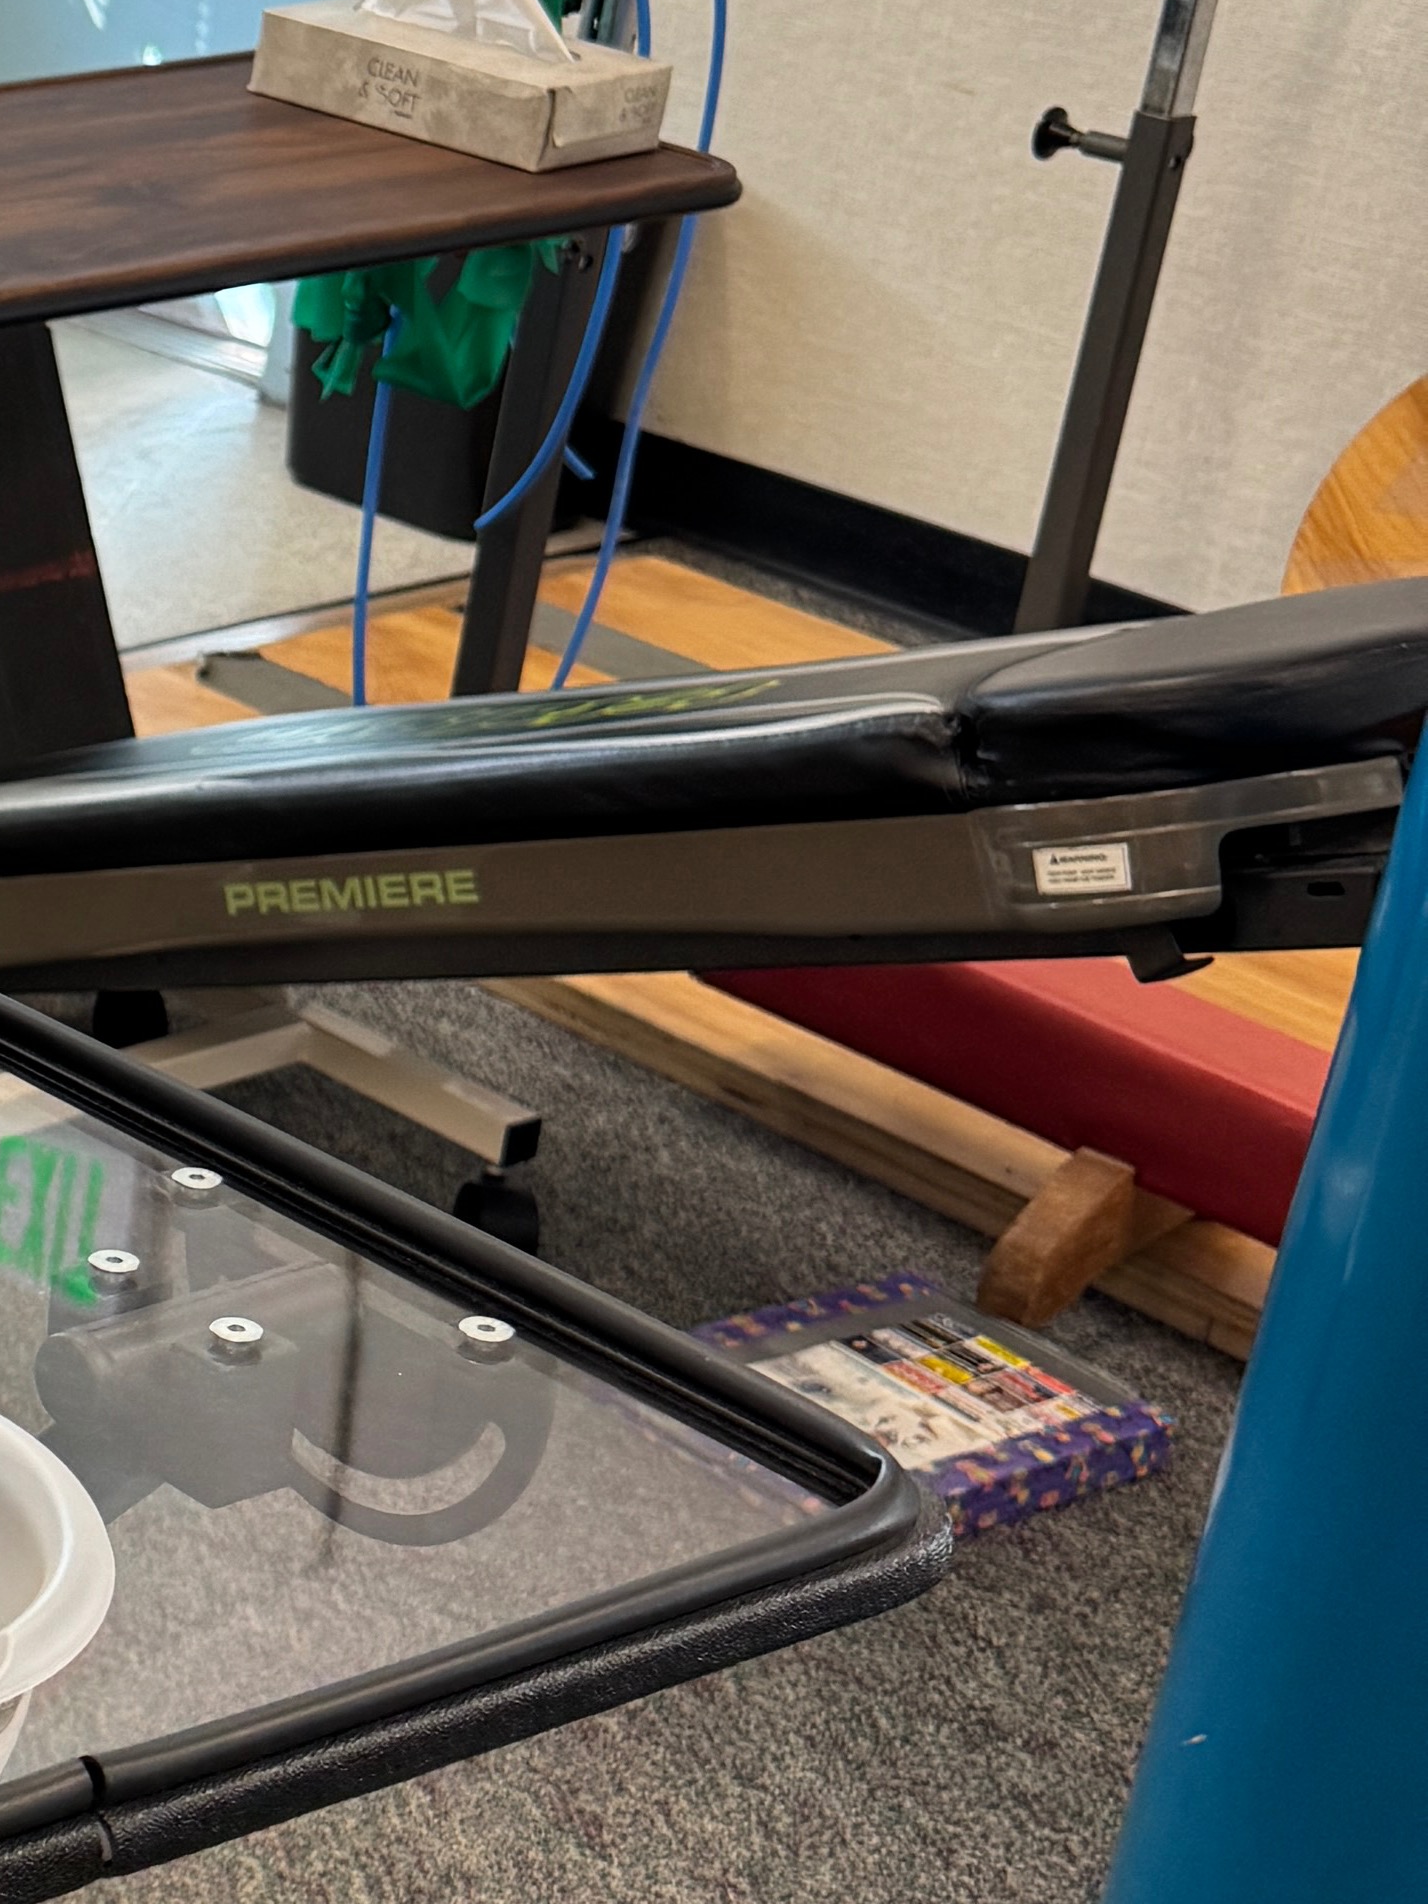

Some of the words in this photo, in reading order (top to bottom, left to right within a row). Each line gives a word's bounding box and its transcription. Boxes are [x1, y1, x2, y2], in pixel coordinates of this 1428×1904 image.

[367, 56, 420, 89] CLEAN
[375, 83, 423, 113] SOFT
[223, 869, 480, 917] PREMIERE
